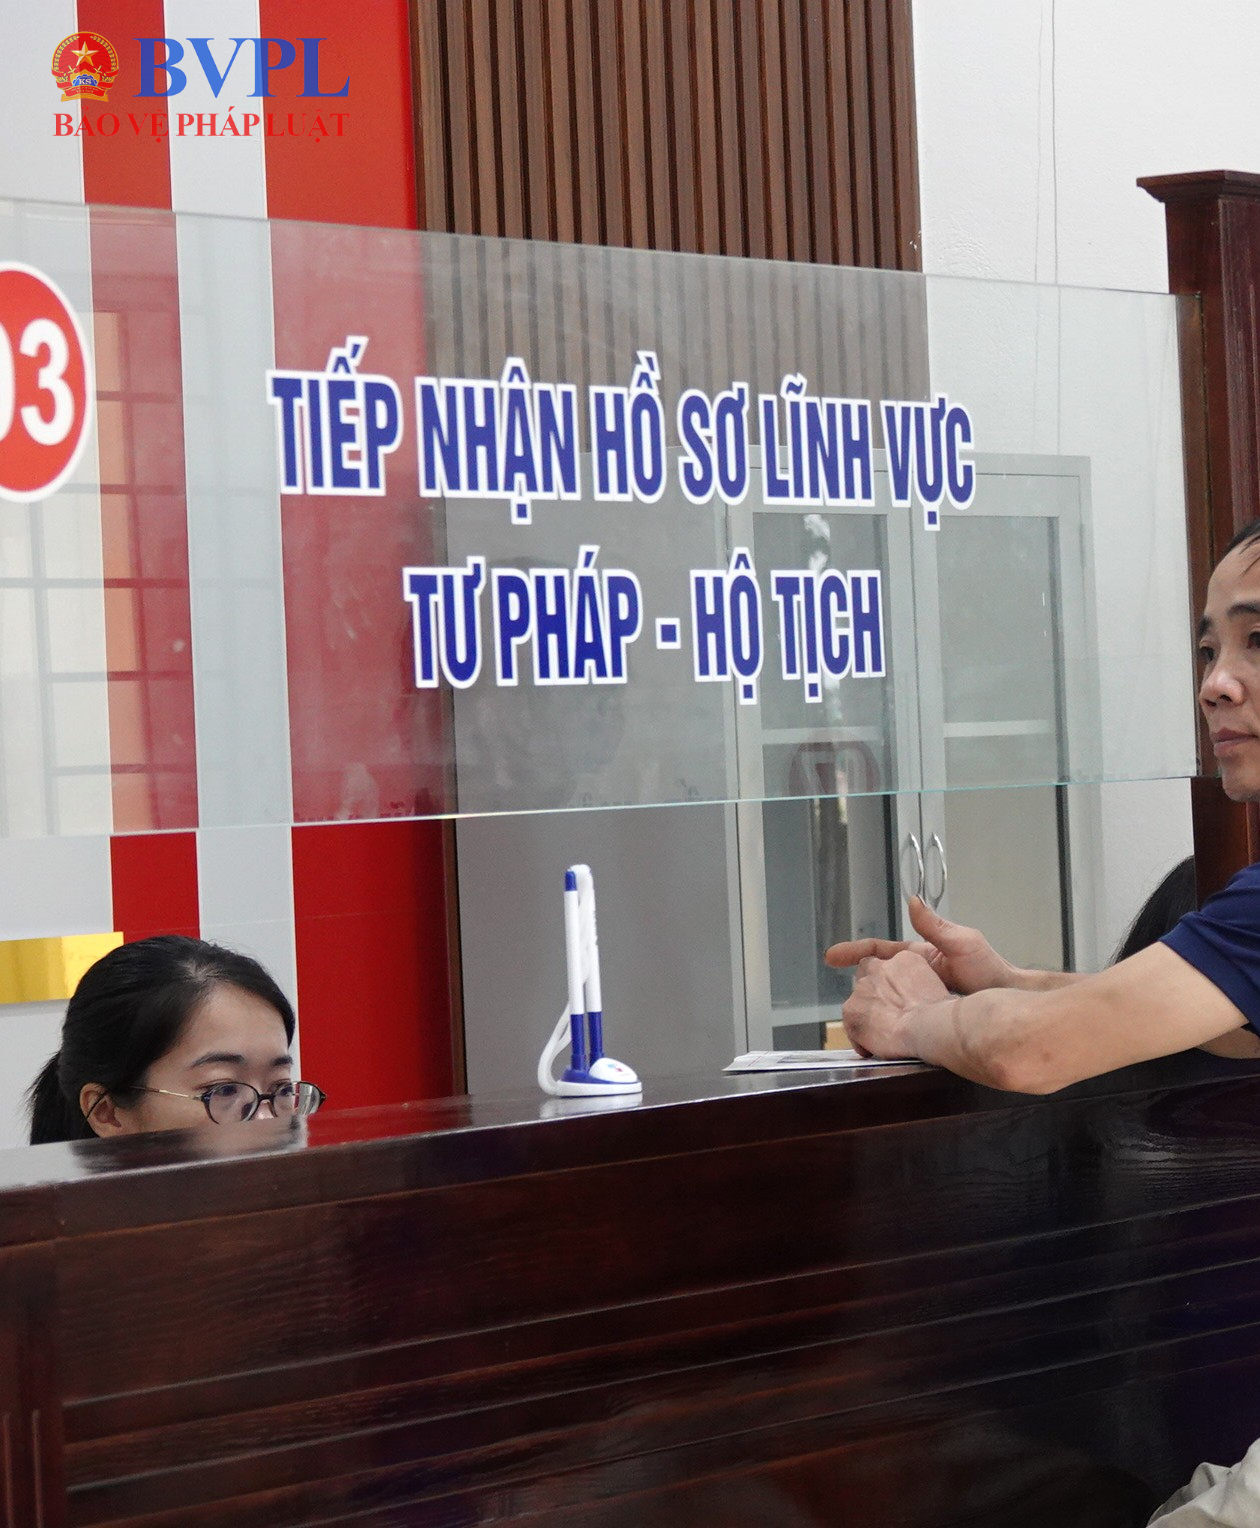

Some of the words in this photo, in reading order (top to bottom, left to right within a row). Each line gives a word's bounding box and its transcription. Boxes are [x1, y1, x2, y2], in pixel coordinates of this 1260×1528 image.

[0, 317, 75, 446] 3
[270, 341, 401, 493] TIẾP
[418, 366, 579, 521] NHẬN
[592, 354, 665, 501] HỒ
[679, 385, 749, 501] SƠ
[762, 375, 874, 504] LĨNH
[883, 396, 976, 527] VỰC
[406, 560, 484, 684] TƯ
[495, 548, 642, 683] PHÁP
[658, 622, 680, 646] -
[692, 552, 763, 701] HỘ
[773, 573, 884, 700] TỊCH
